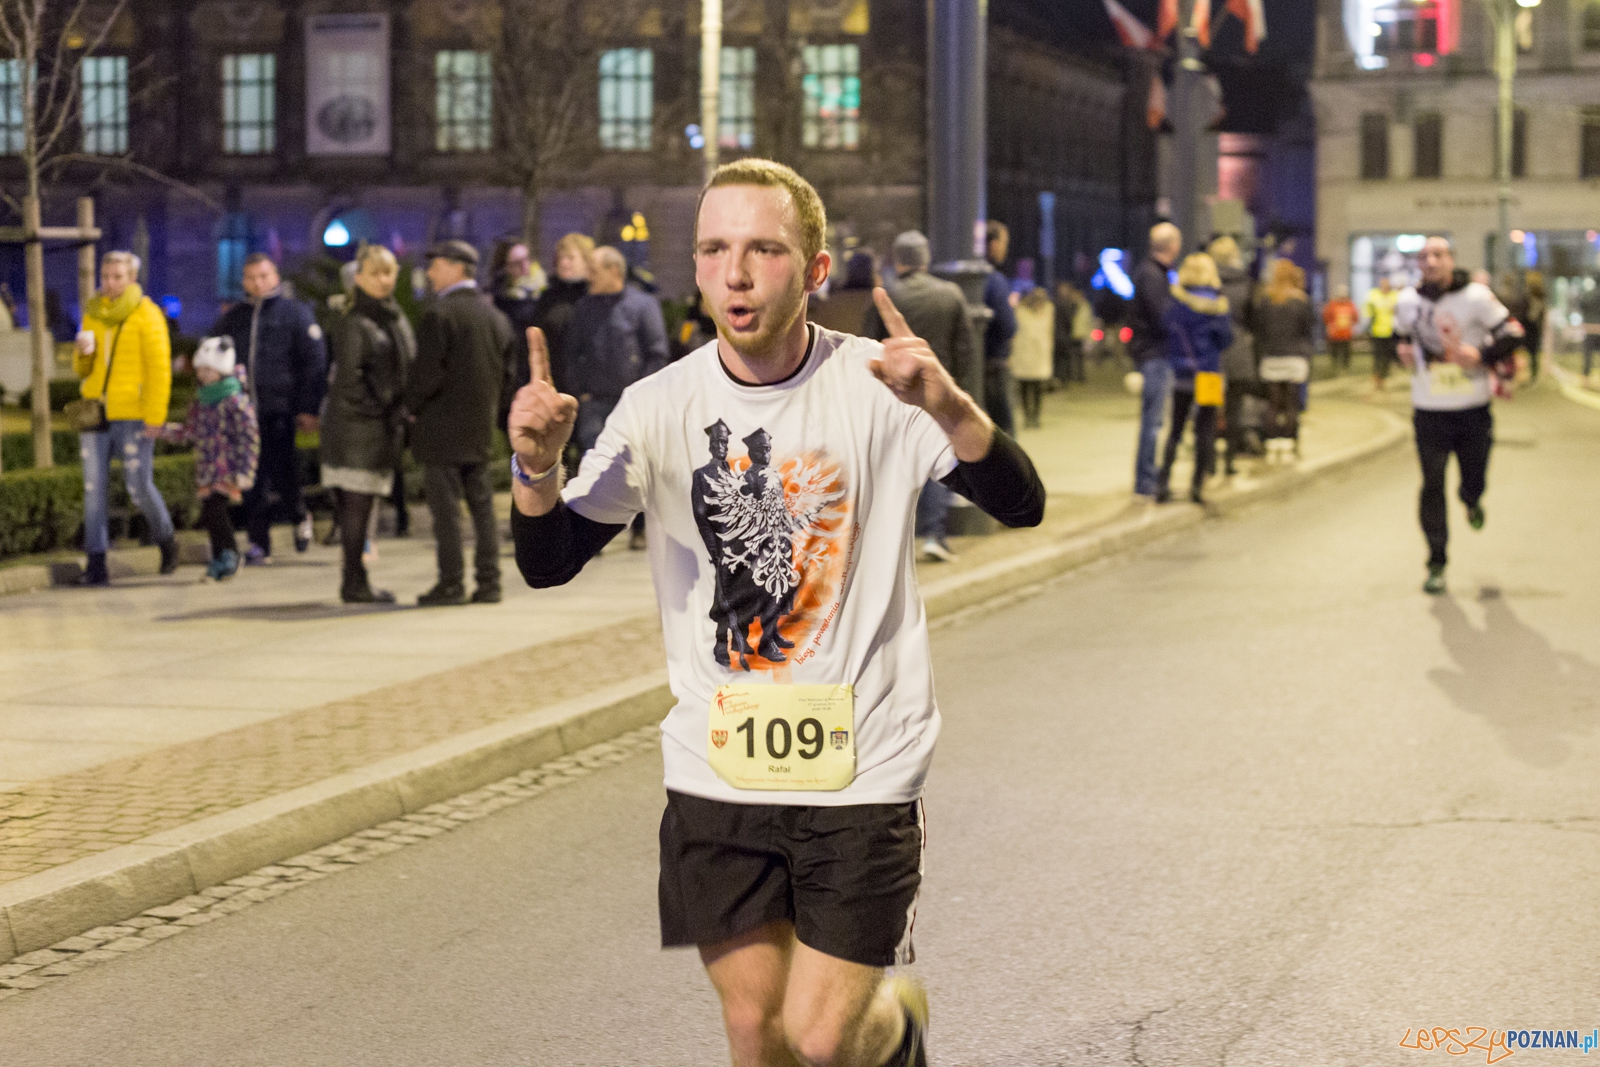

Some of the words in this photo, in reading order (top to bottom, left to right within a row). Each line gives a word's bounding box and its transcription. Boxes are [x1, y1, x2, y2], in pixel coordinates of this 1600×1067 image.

[794, 647, 816, 665] bieg
[813, 601, 841, 647] powstania
[736, 716, 825, 760] 109
